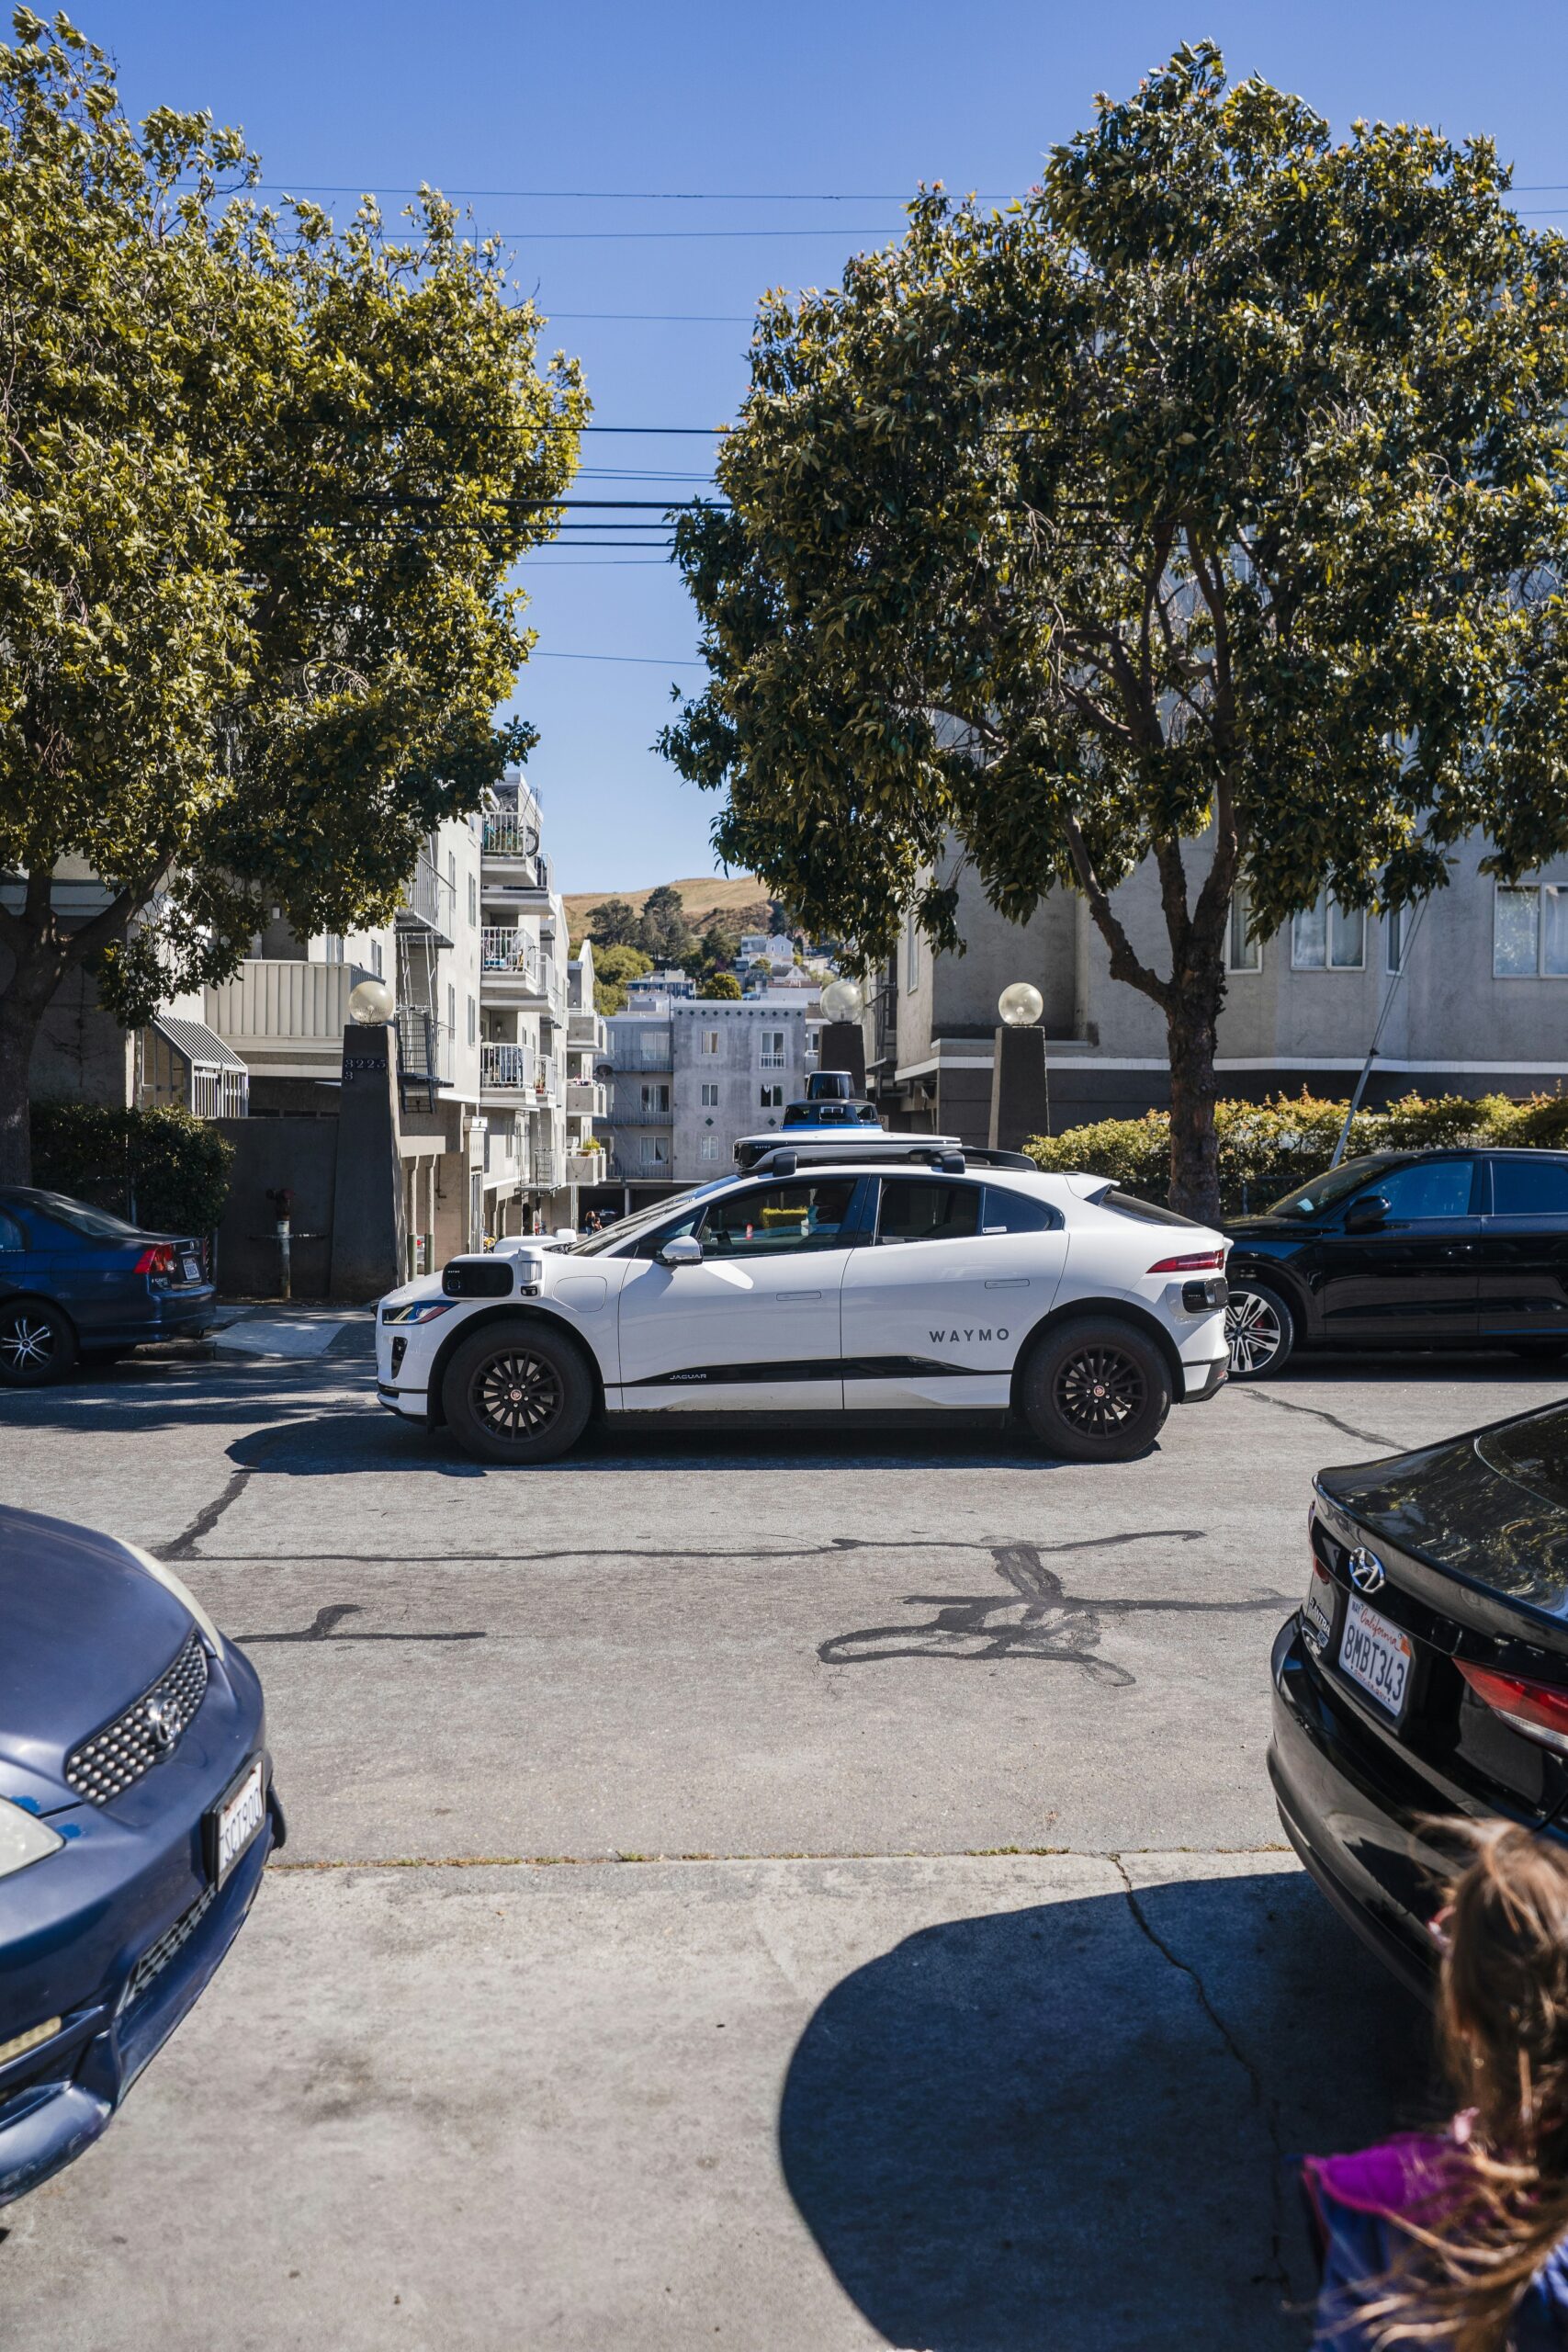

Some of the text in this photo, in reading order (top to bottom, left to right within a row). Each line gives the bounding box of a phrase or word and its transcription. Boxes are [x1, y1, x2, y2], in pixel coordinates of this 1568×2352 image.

[344, 1058, 386, 1069] 3225
[344, 1070, 354, 1080] 3
[928, 1328, 1010, 1343] WAYMO
[1359, 1607, 1401, 1652] California
[1344, 1624, 1404, 1701] 8MBT343
